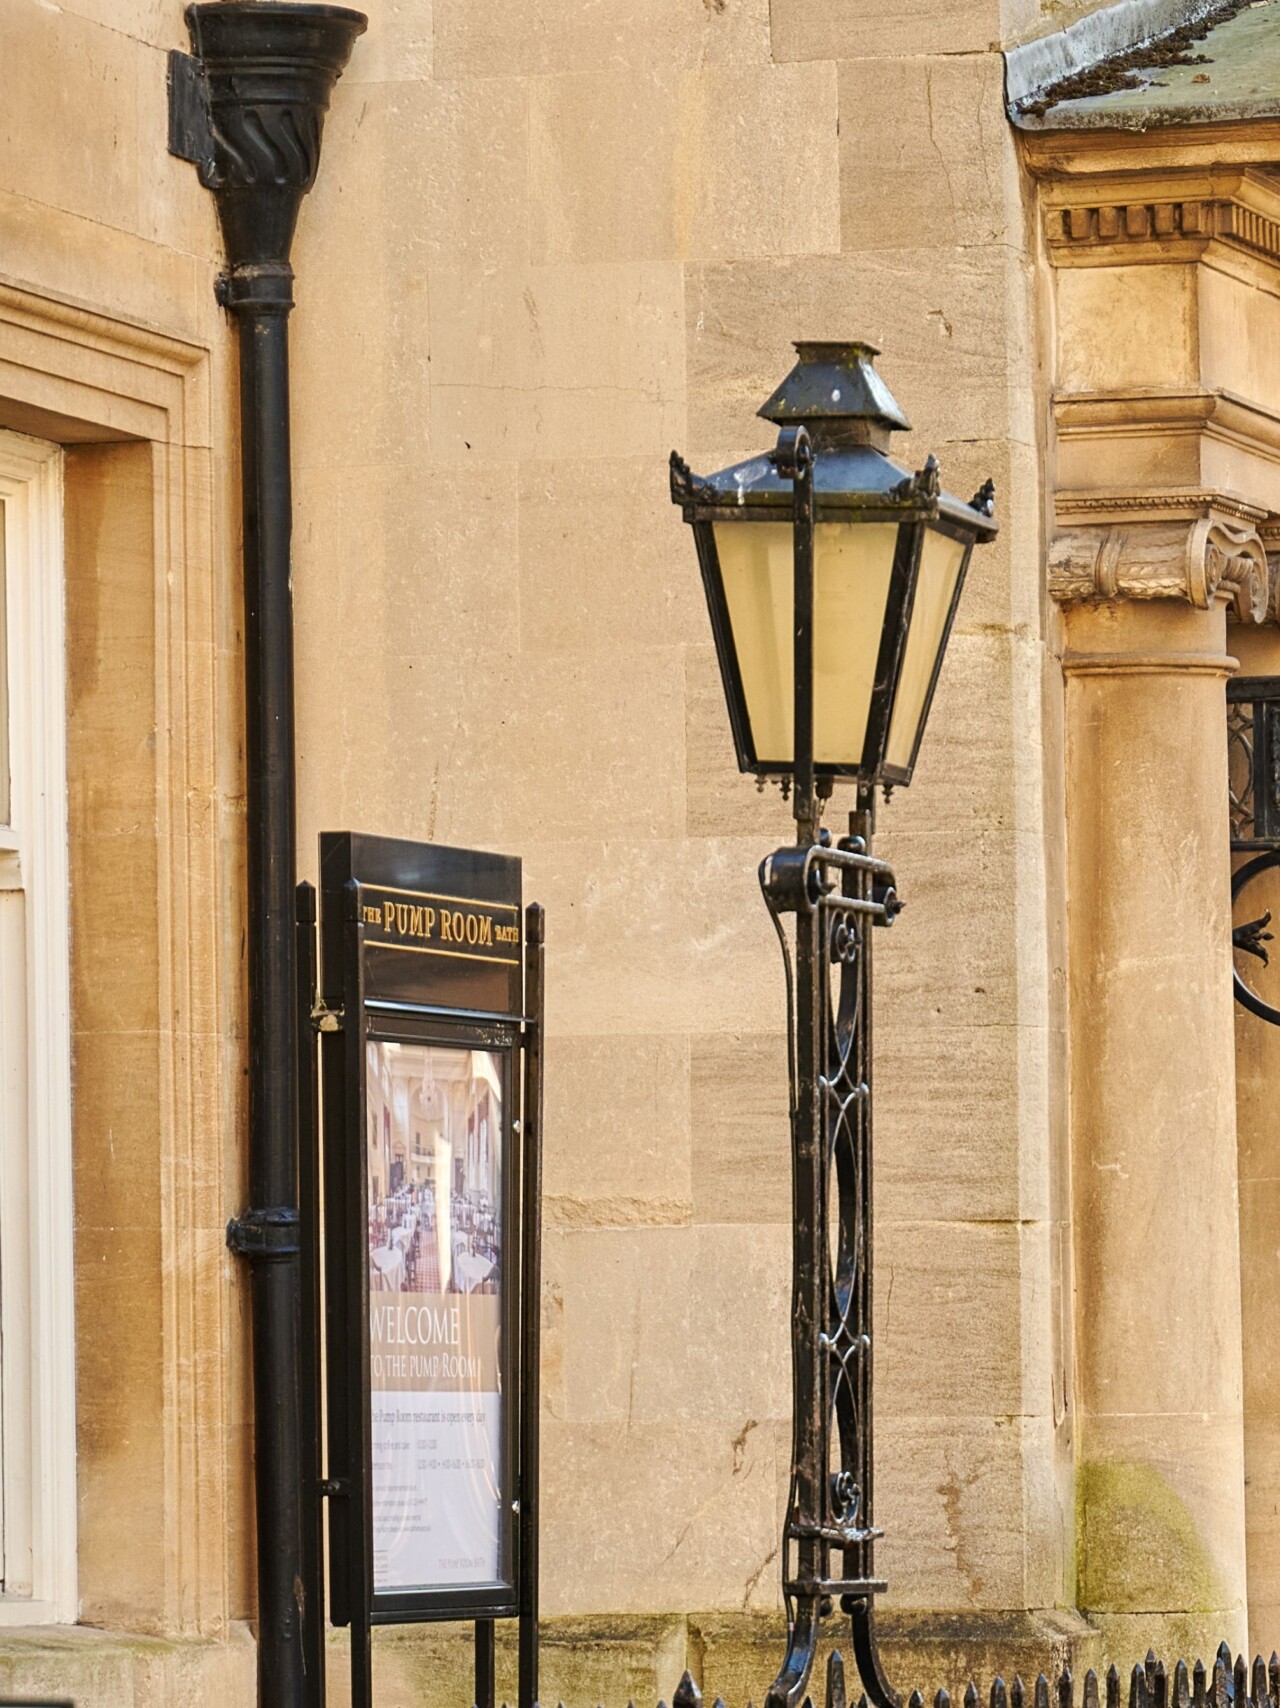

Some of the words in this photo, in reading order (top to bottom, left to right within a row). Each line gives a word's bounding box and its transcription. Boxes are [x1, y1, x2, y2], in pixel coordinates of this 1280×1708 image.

[363, 906, 381, 924] THE
[383, 901, 436, 938] PUMP
[440, 908, 493, 946] ROOM
[494, 925, 519, 943] BATH
[370, 1306, 460, 1345] WELCOME
[385, 1355, 406, 1377] THE
[410, 1355, 439, 1377] PUMP
